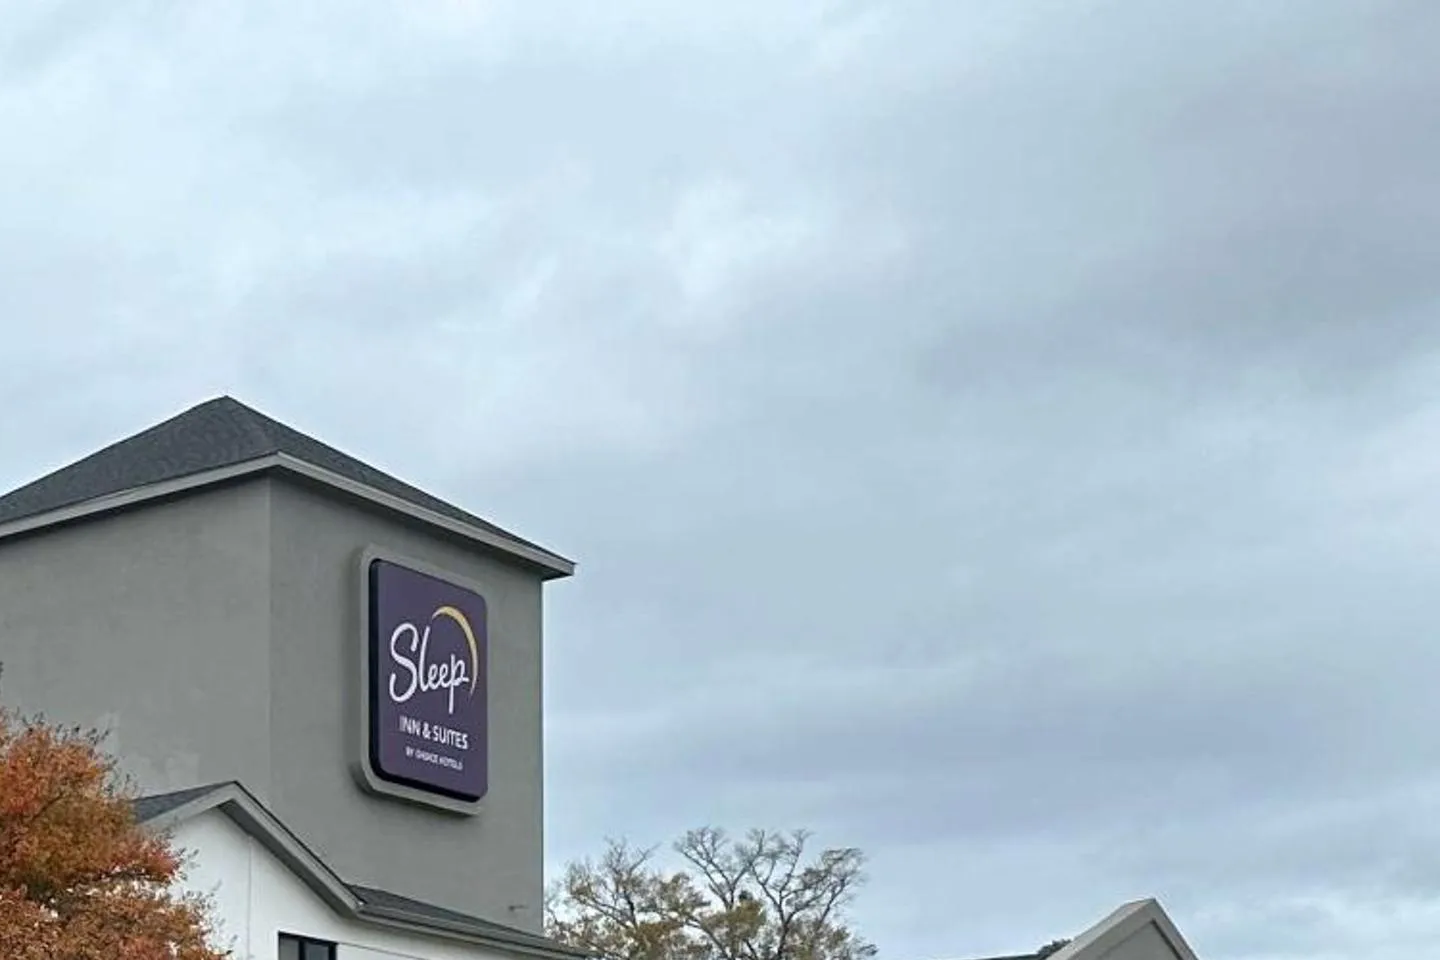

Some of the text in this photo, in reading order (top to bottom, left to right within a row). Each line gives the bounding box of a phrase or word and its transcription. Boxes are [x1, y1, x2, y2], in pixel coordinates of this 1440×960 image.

[389, 622, 470, 714] Sleep
[399, 715, 468, 750] INN & SUITES
